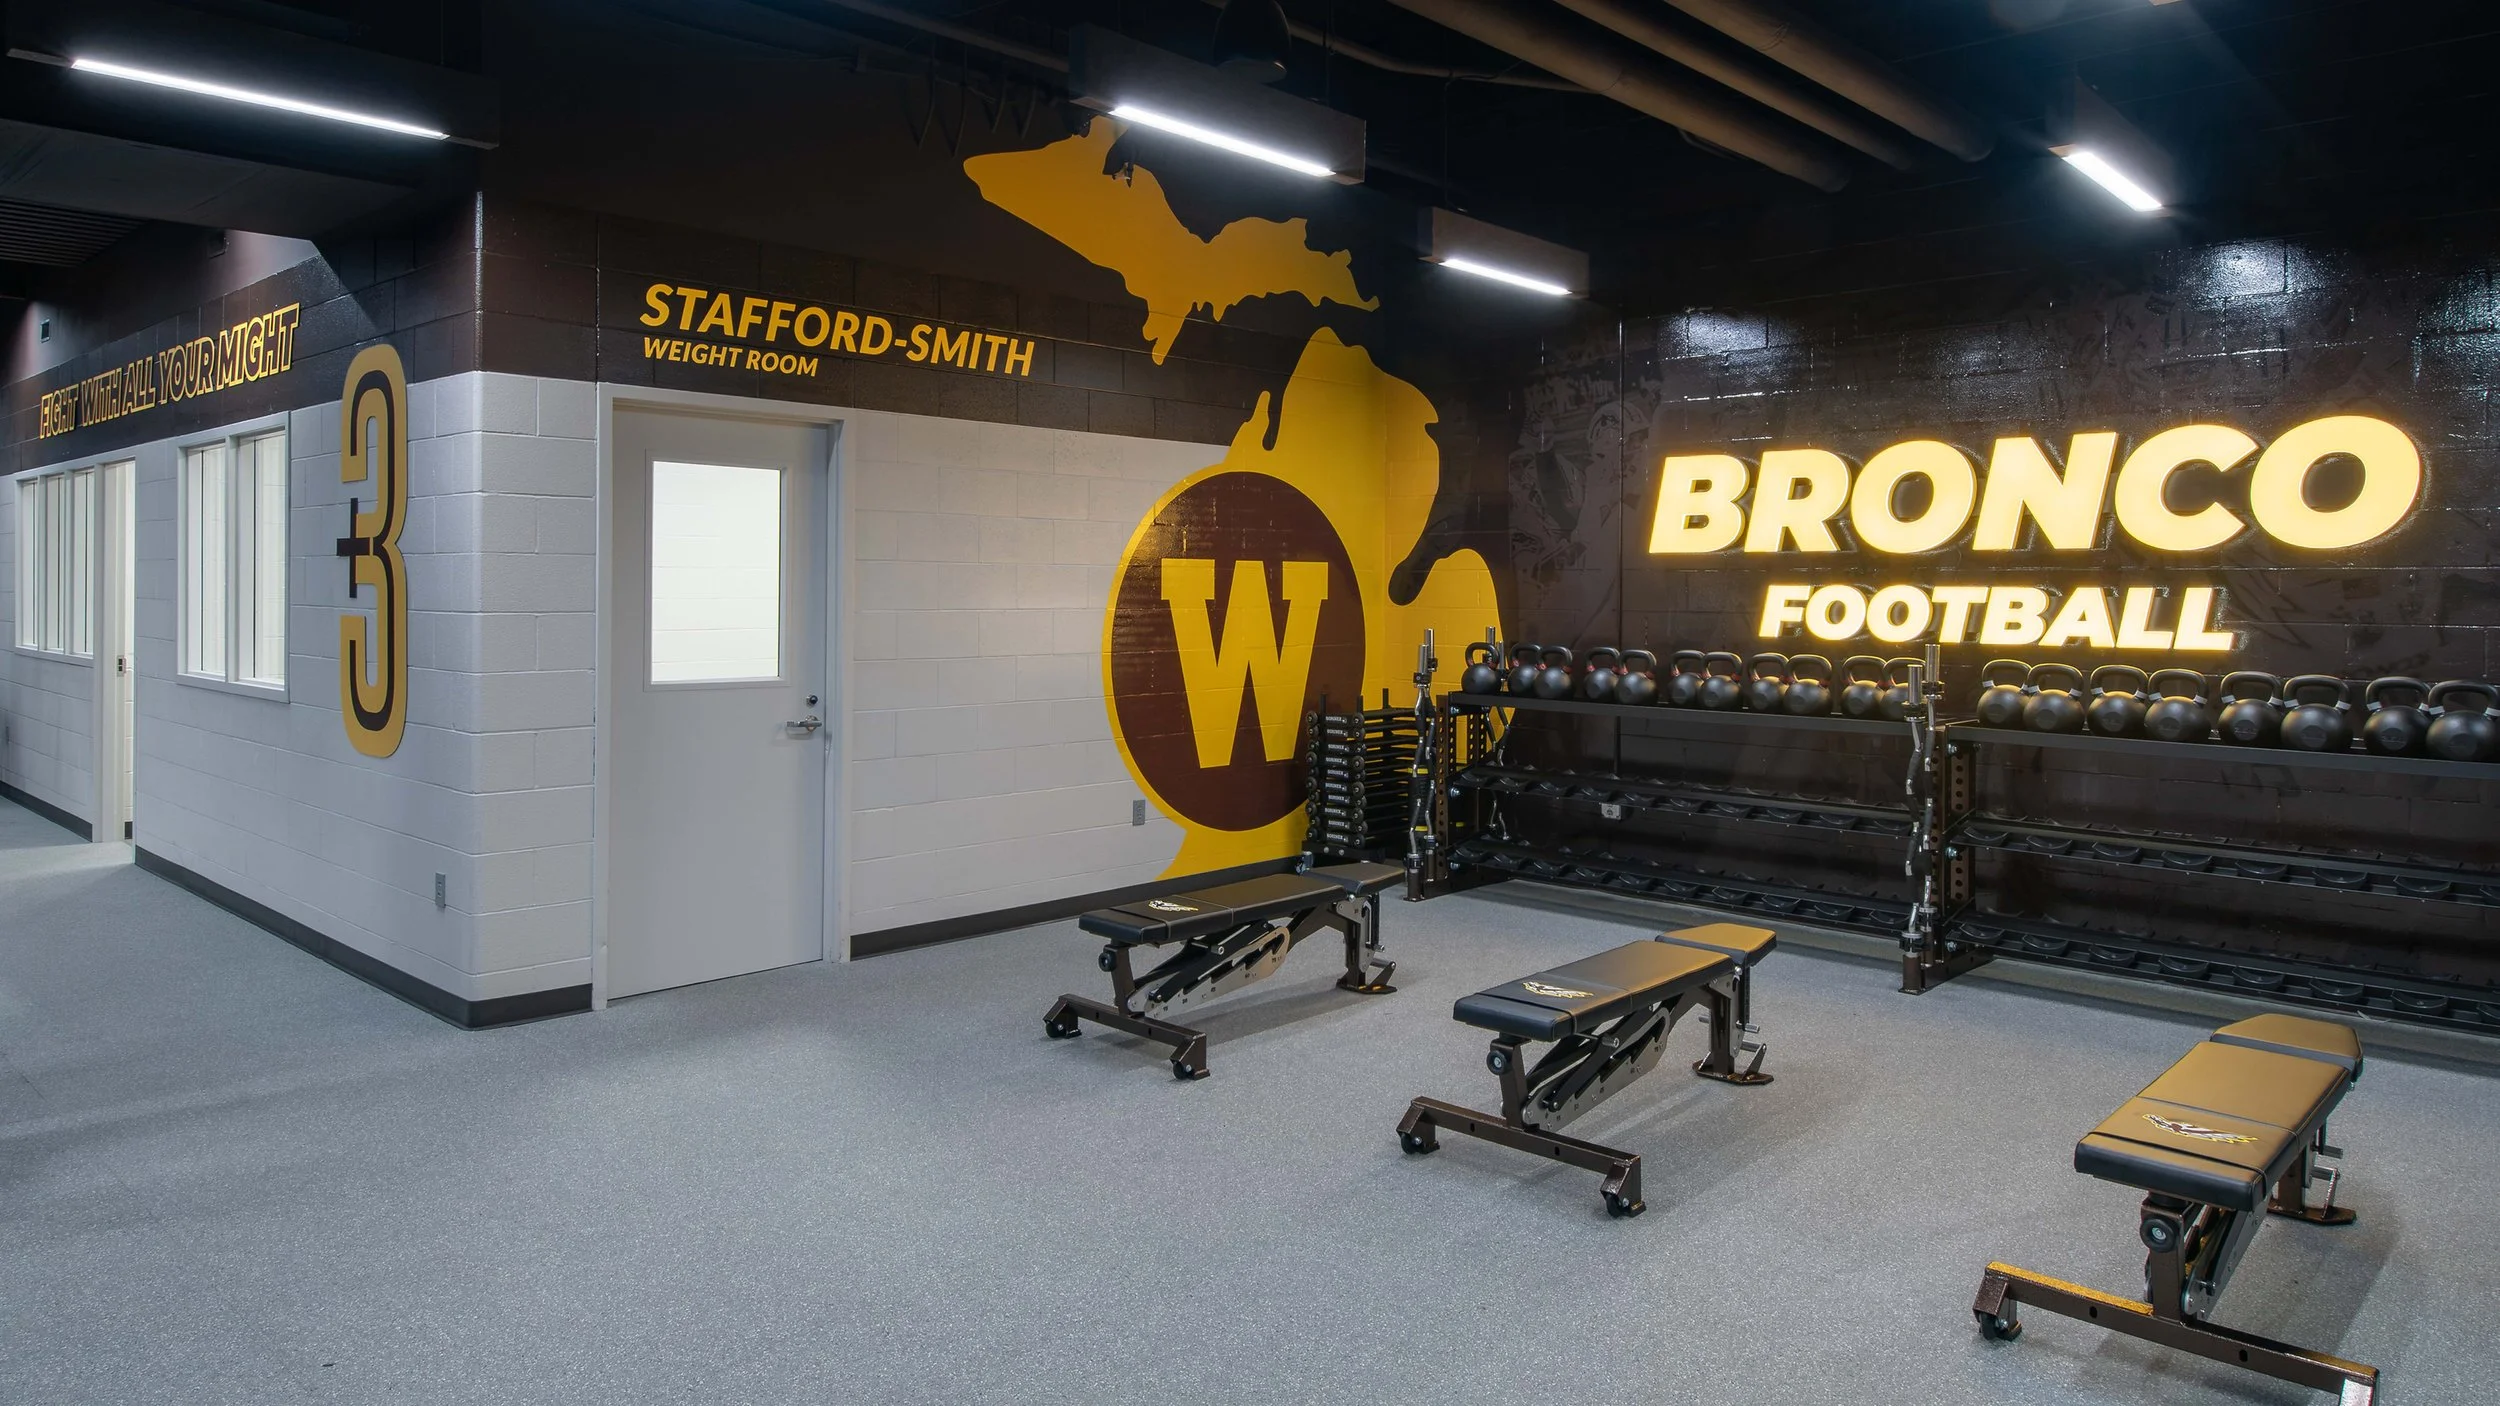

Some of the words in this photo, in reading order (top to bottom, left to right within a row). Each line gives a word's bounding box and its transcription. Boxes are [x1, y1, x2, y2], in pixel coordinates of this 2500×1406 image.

[40, 384, 79, 439] FIGHT
[81, 368, 122, 427] WITH
[121, 356, 156, 416] ALL
[159, 337, 214, 404] YOUR
[216, 302, 300, 391] MIGHT
[639, 283, 1035, 376] STAFFORD-SMITH
[643, 337, 743, 368] WEIGHT
[745, 351, 819, 377] ROOM
[340, 343, 408, 759] 3
[1648, 414, 2424, 554] BRONCO
[1161, 558, 1328, 768] W
[1757, 584, 2237, 651] FOOTBALL
